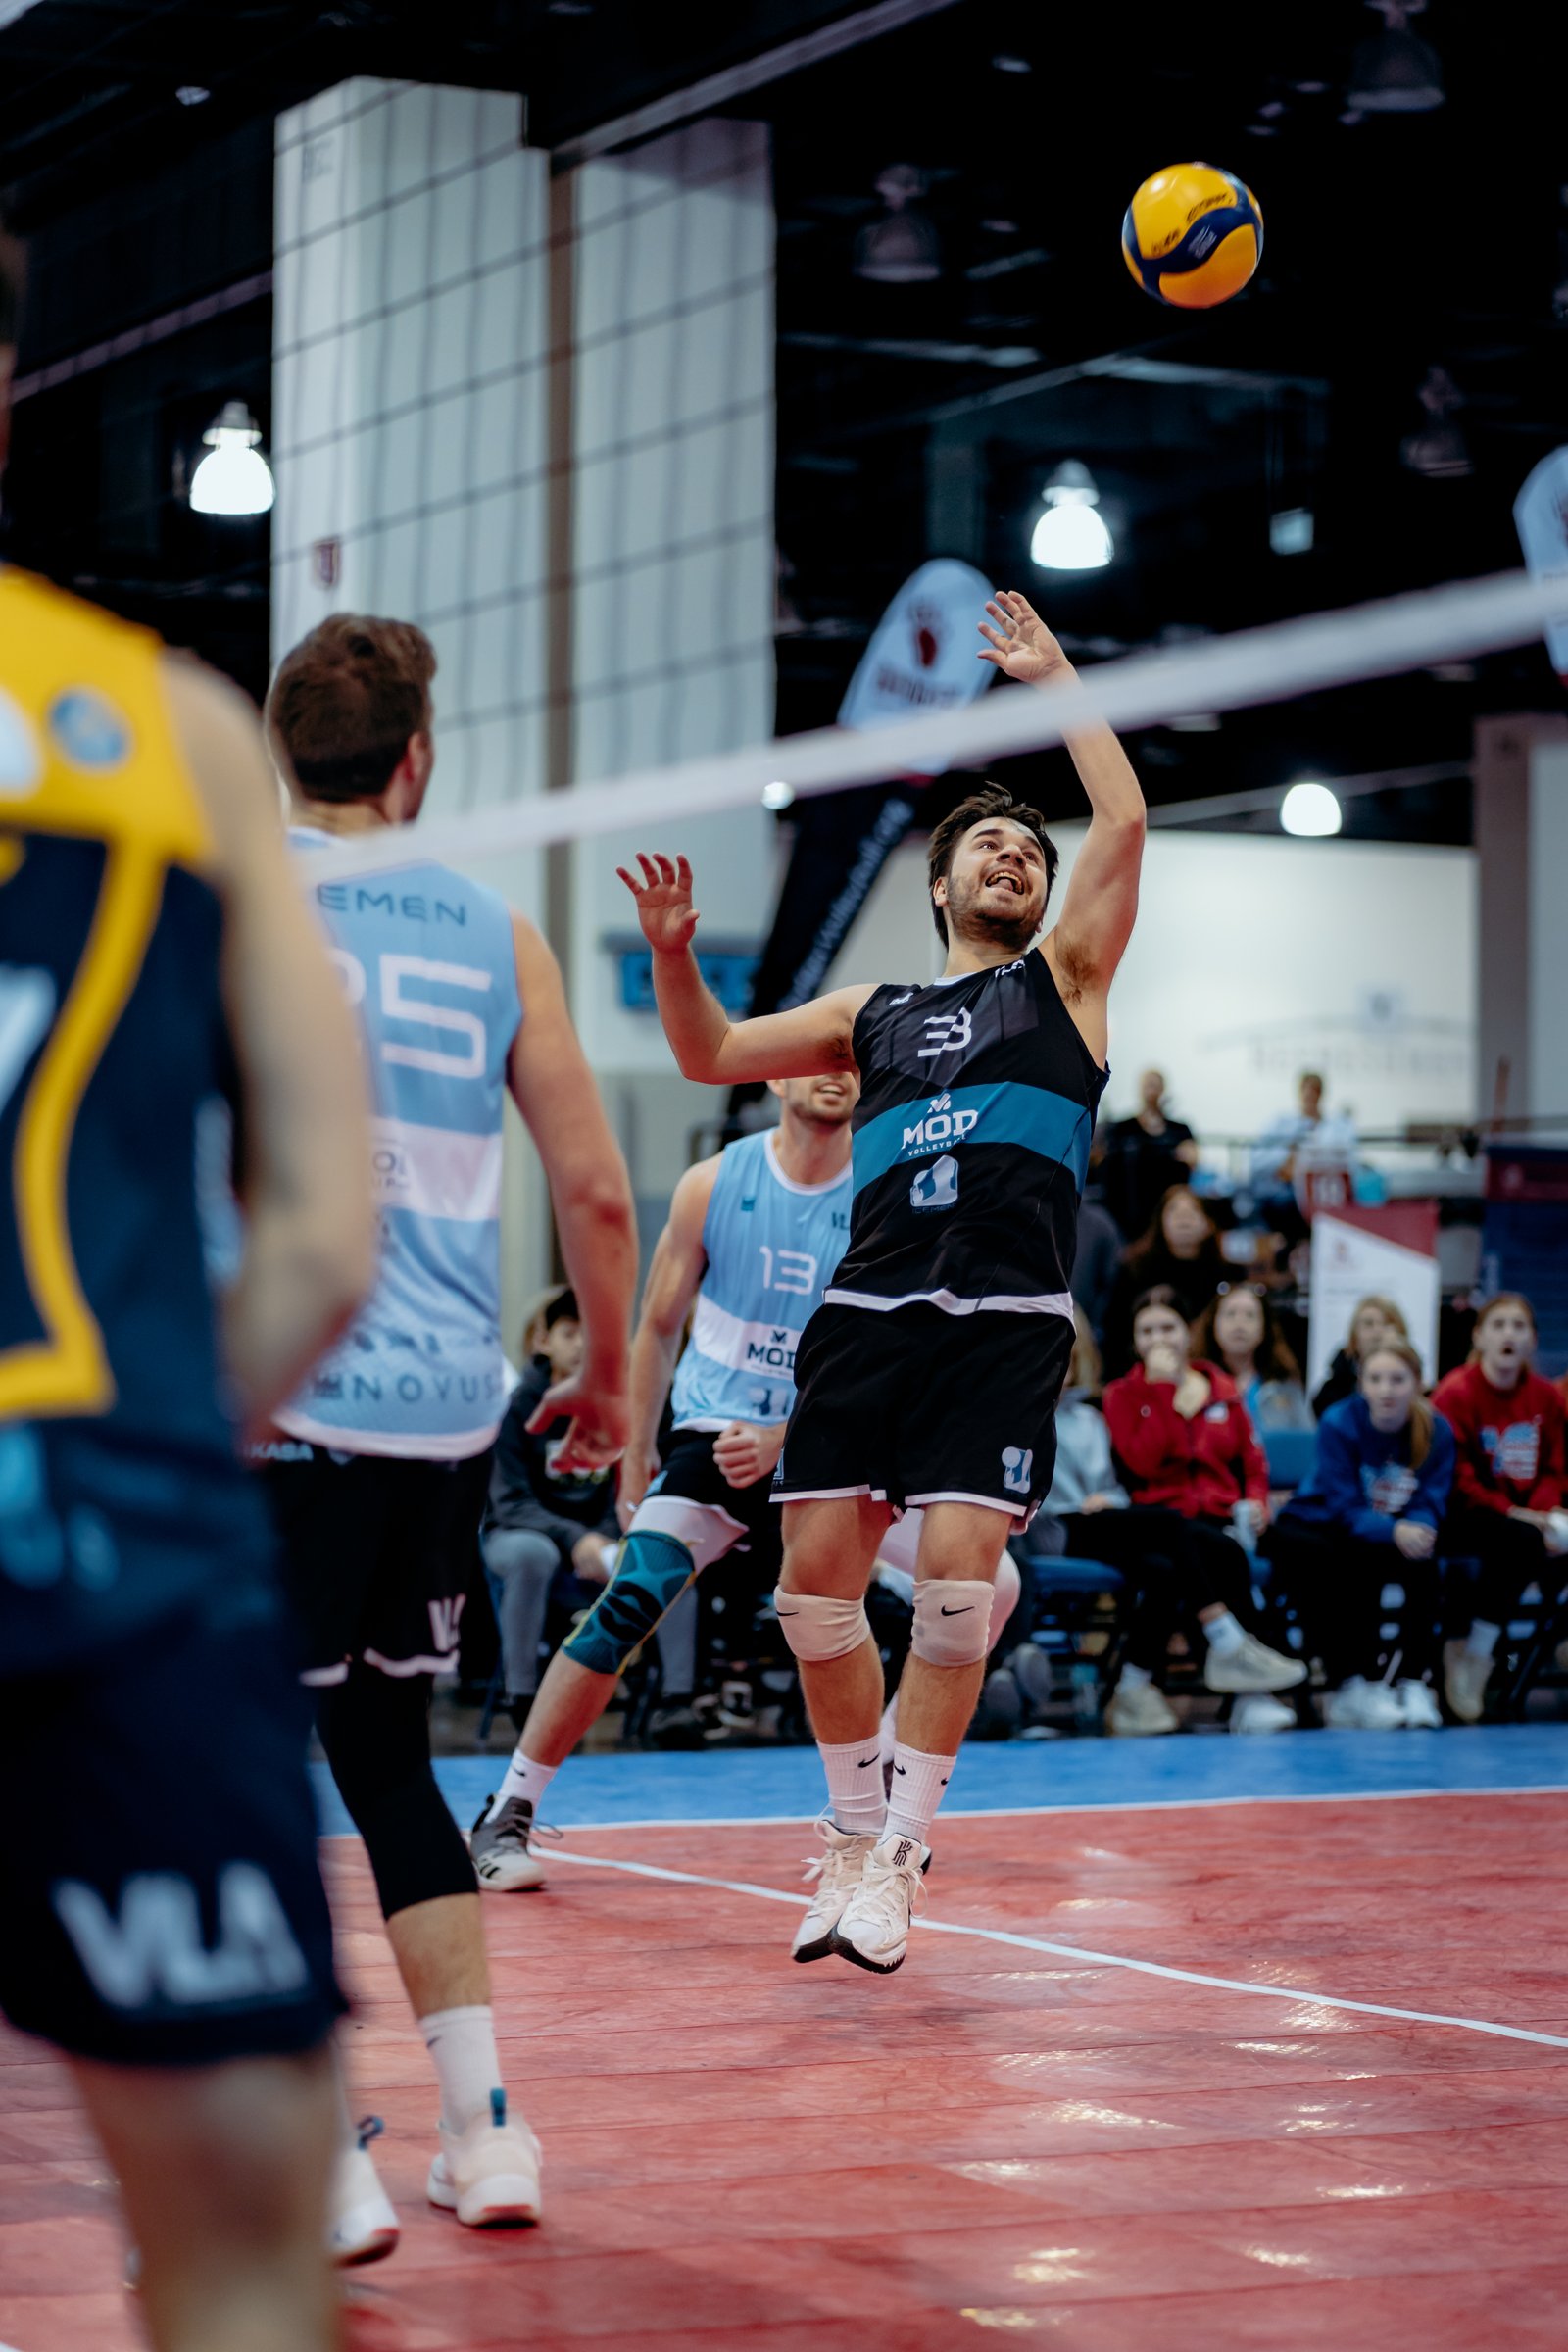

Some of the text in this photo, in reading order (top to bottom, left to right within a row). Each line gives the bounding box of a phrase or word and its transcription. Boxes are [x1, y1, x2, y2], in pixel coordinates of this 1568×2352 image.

[316, 883, 467, 926] EMEN
[917, 1006, 972, 1058] 3
[901, 1108, 978, 1150] MOD
[759, 1245, 816, 1296] 13
